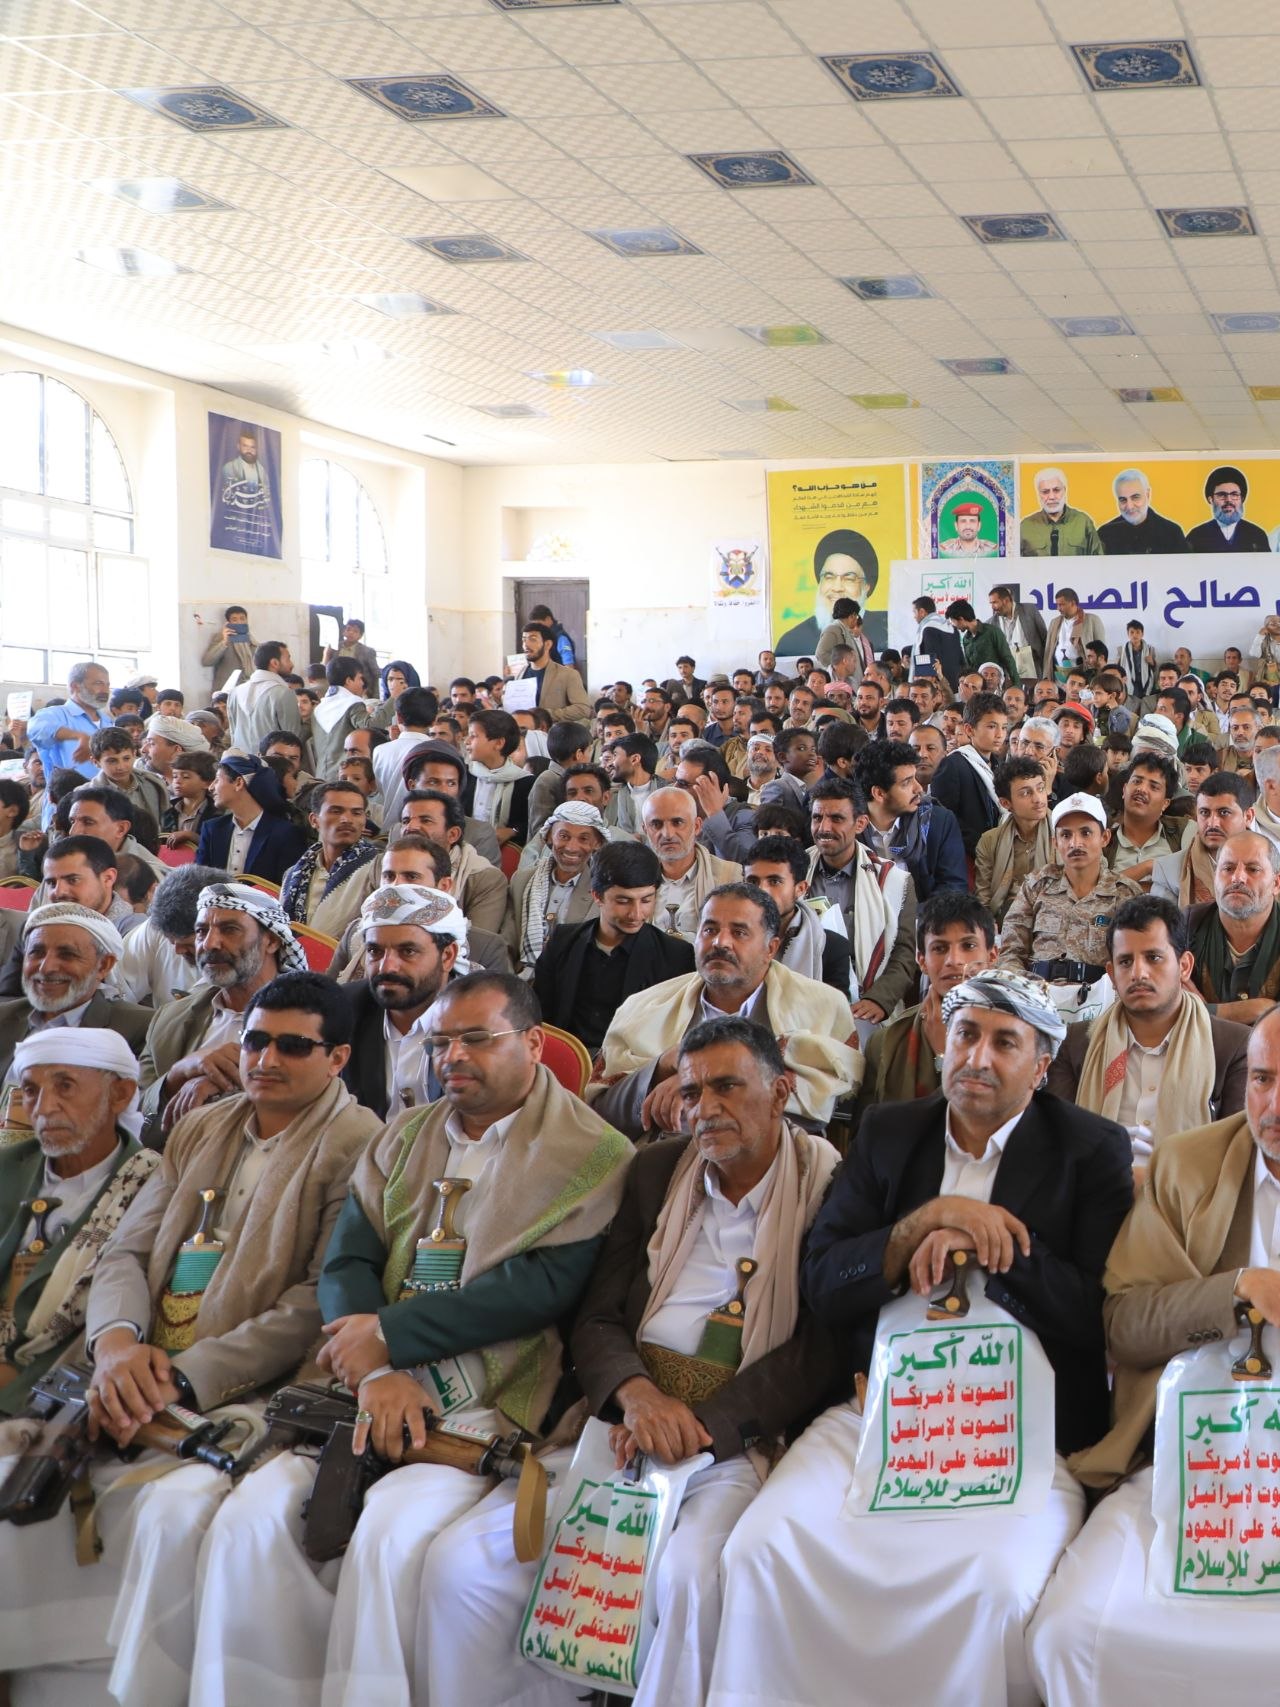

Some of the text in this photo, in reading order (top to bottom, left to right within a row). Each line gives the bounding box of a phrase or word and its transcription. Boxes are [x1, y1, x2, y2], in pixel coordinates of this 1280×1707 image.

[925, 575, 972, 593] الله أكبر
[1029, 580, 1148, 611] الصاد
[1164, 579, 1261, 629] صالح
[890, 1332, 1015, 1382] الله أكبر
[890, 1378, 1015, 1410] الموت لأمريكا
[890, 1413, 1015, 1444] الموت لإسرائيل
[1186, 1397, 1260, 1445] أكبر
[888, 1446, 1015, 1475] اللعنة على اليهود
[1187, 1445, 1251, 1475] لأمريكا
[879, 1473, 1013, 1504] النصر للإسلام
[1187, 1481, 1253, 1510] لإسرائيل
[1185, 1518, 1234, 1544] اليهود
[1239, 1517, 1264, 1544] على
[1183, 1548, 1250, 1587] للإسلام
[534, 1602, 576, 1630] اليهود
[583, 1651, 630, 1681] النصر
